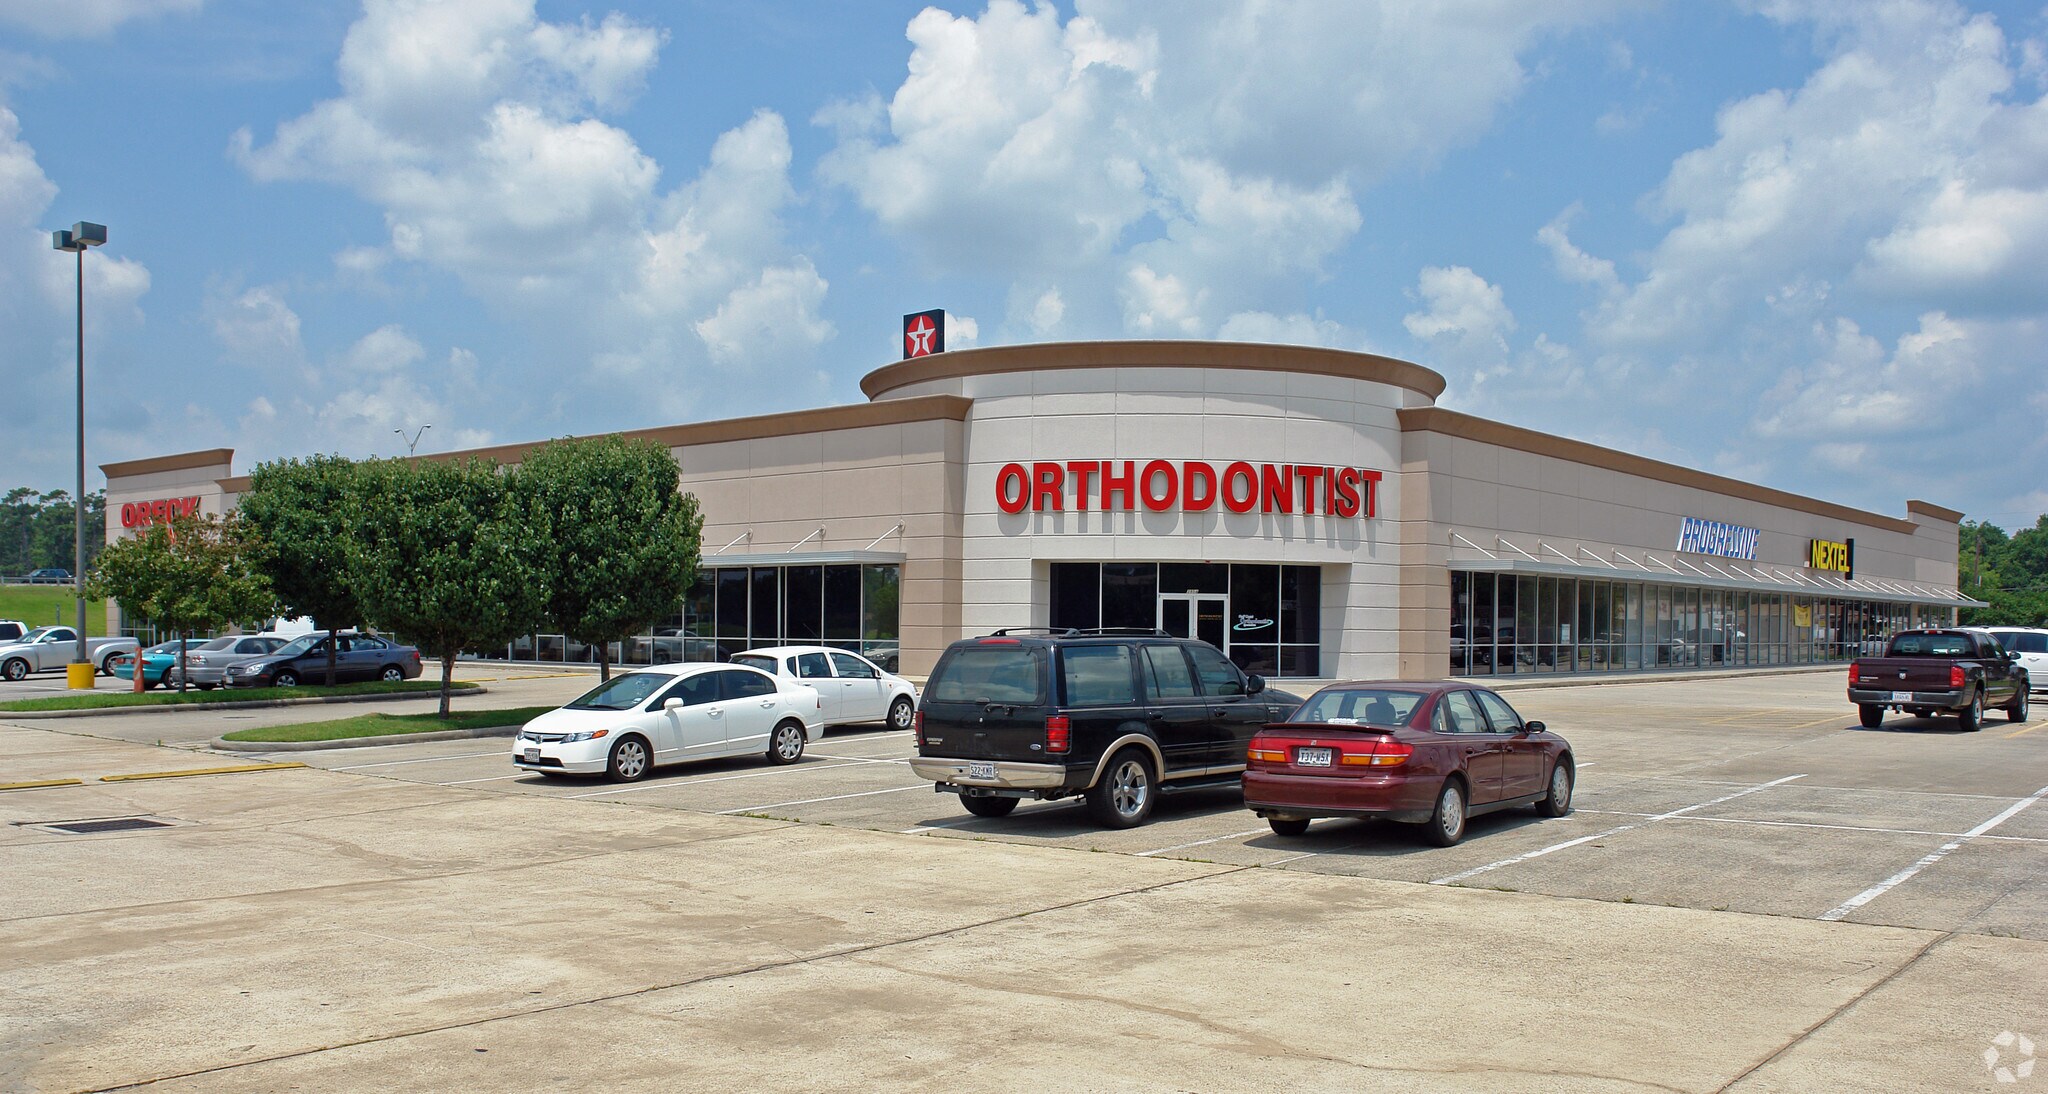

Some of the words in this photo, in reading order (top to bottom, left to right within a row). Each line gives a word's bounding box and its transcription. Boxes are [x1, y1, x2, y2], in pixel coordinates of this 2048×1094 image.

[995, 459, 1383, 519] ORTHODONTIST
[121, 496, 201, 528] ORECK
[1677, 517, 1761, 561] PROGRESSIVE
[1811, 539, 1850, 573] NEXTEL
